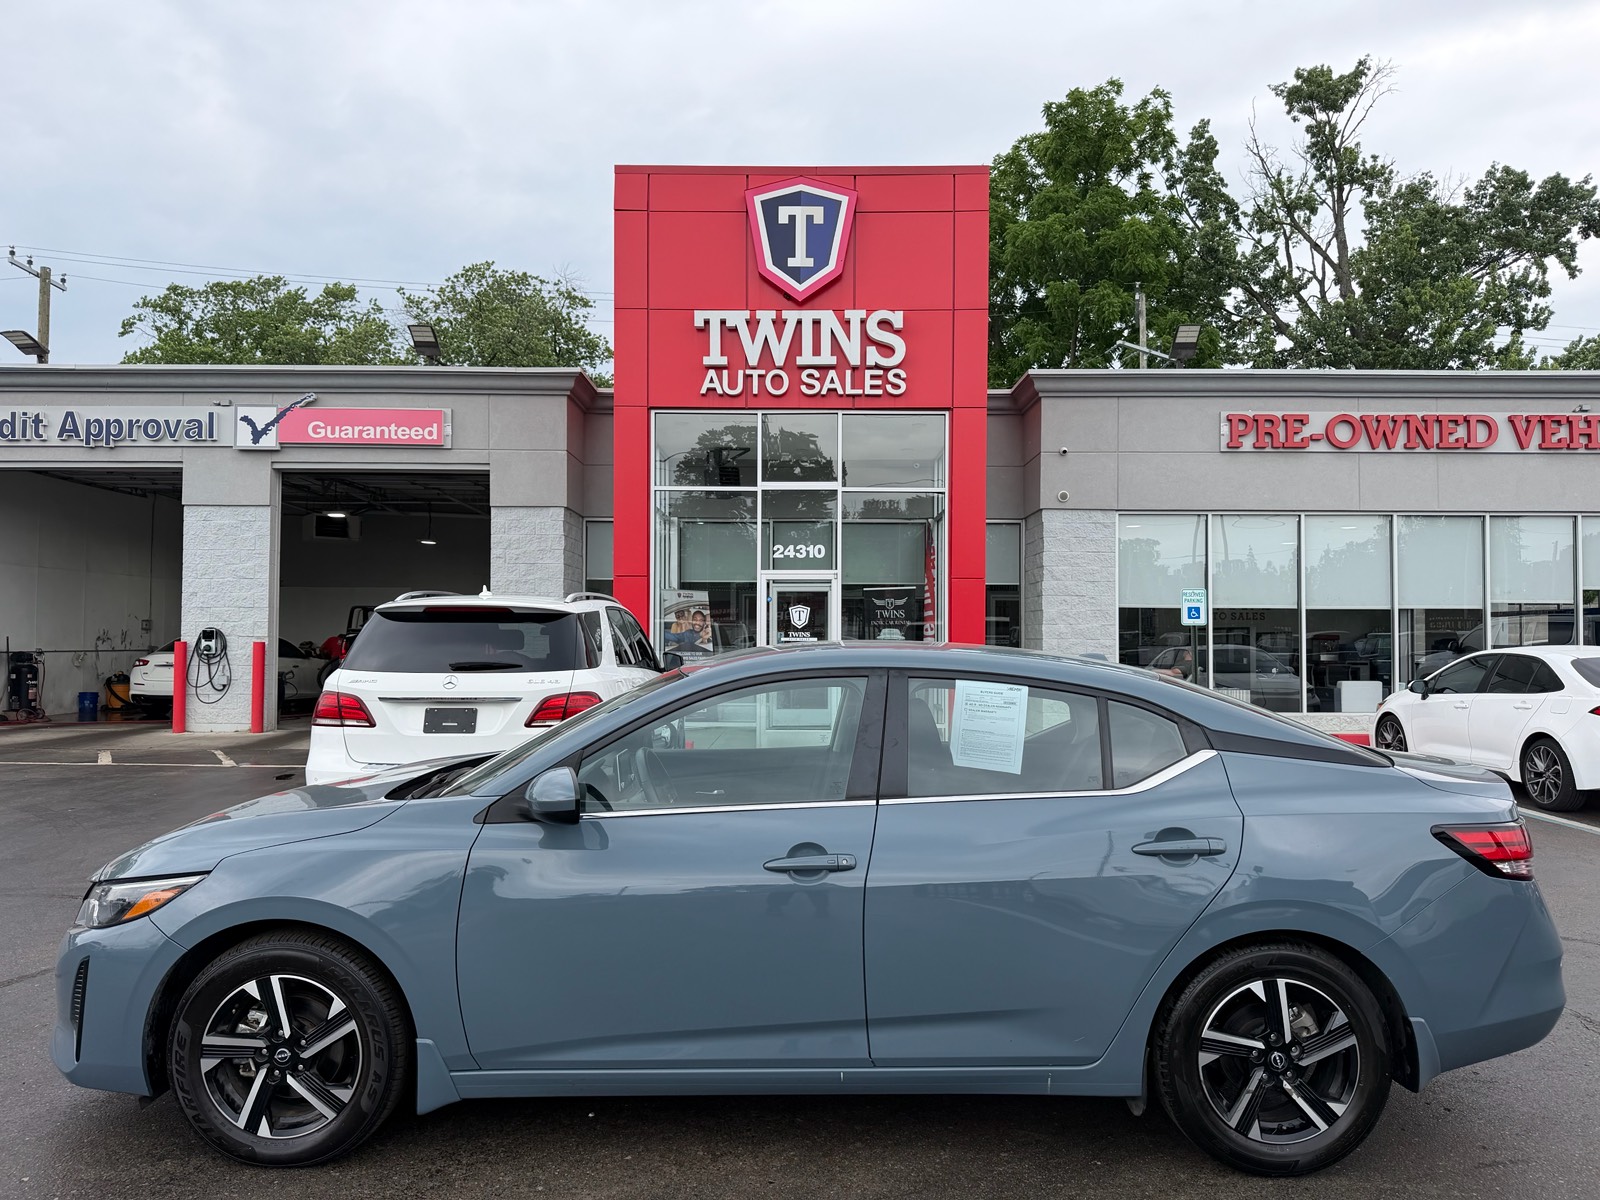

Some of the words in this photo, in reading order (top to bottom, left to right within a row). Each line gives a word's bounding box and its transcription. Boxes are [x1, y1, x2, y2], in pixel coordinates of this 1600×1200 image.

[778, 206, 824, 267] T
[694, 309, 907, 368] TWINS
[700, 369, 789, 396] AUTO
[800, 369, 907, 396] SALES
[57, 410, 218, 448] Approval
[307, 420, 439, 441] Guaranteed
[1226, 413, 1499, 450] PRE-OWNED
[1508, 413, 1600, 450] VEH
[773, 544, 826, 559] 24310
[875, 609, 906, 619] TWINS
[1231, 611, 1266, 621] SALES
[328, 965, 386, 1058] SOLARUS
